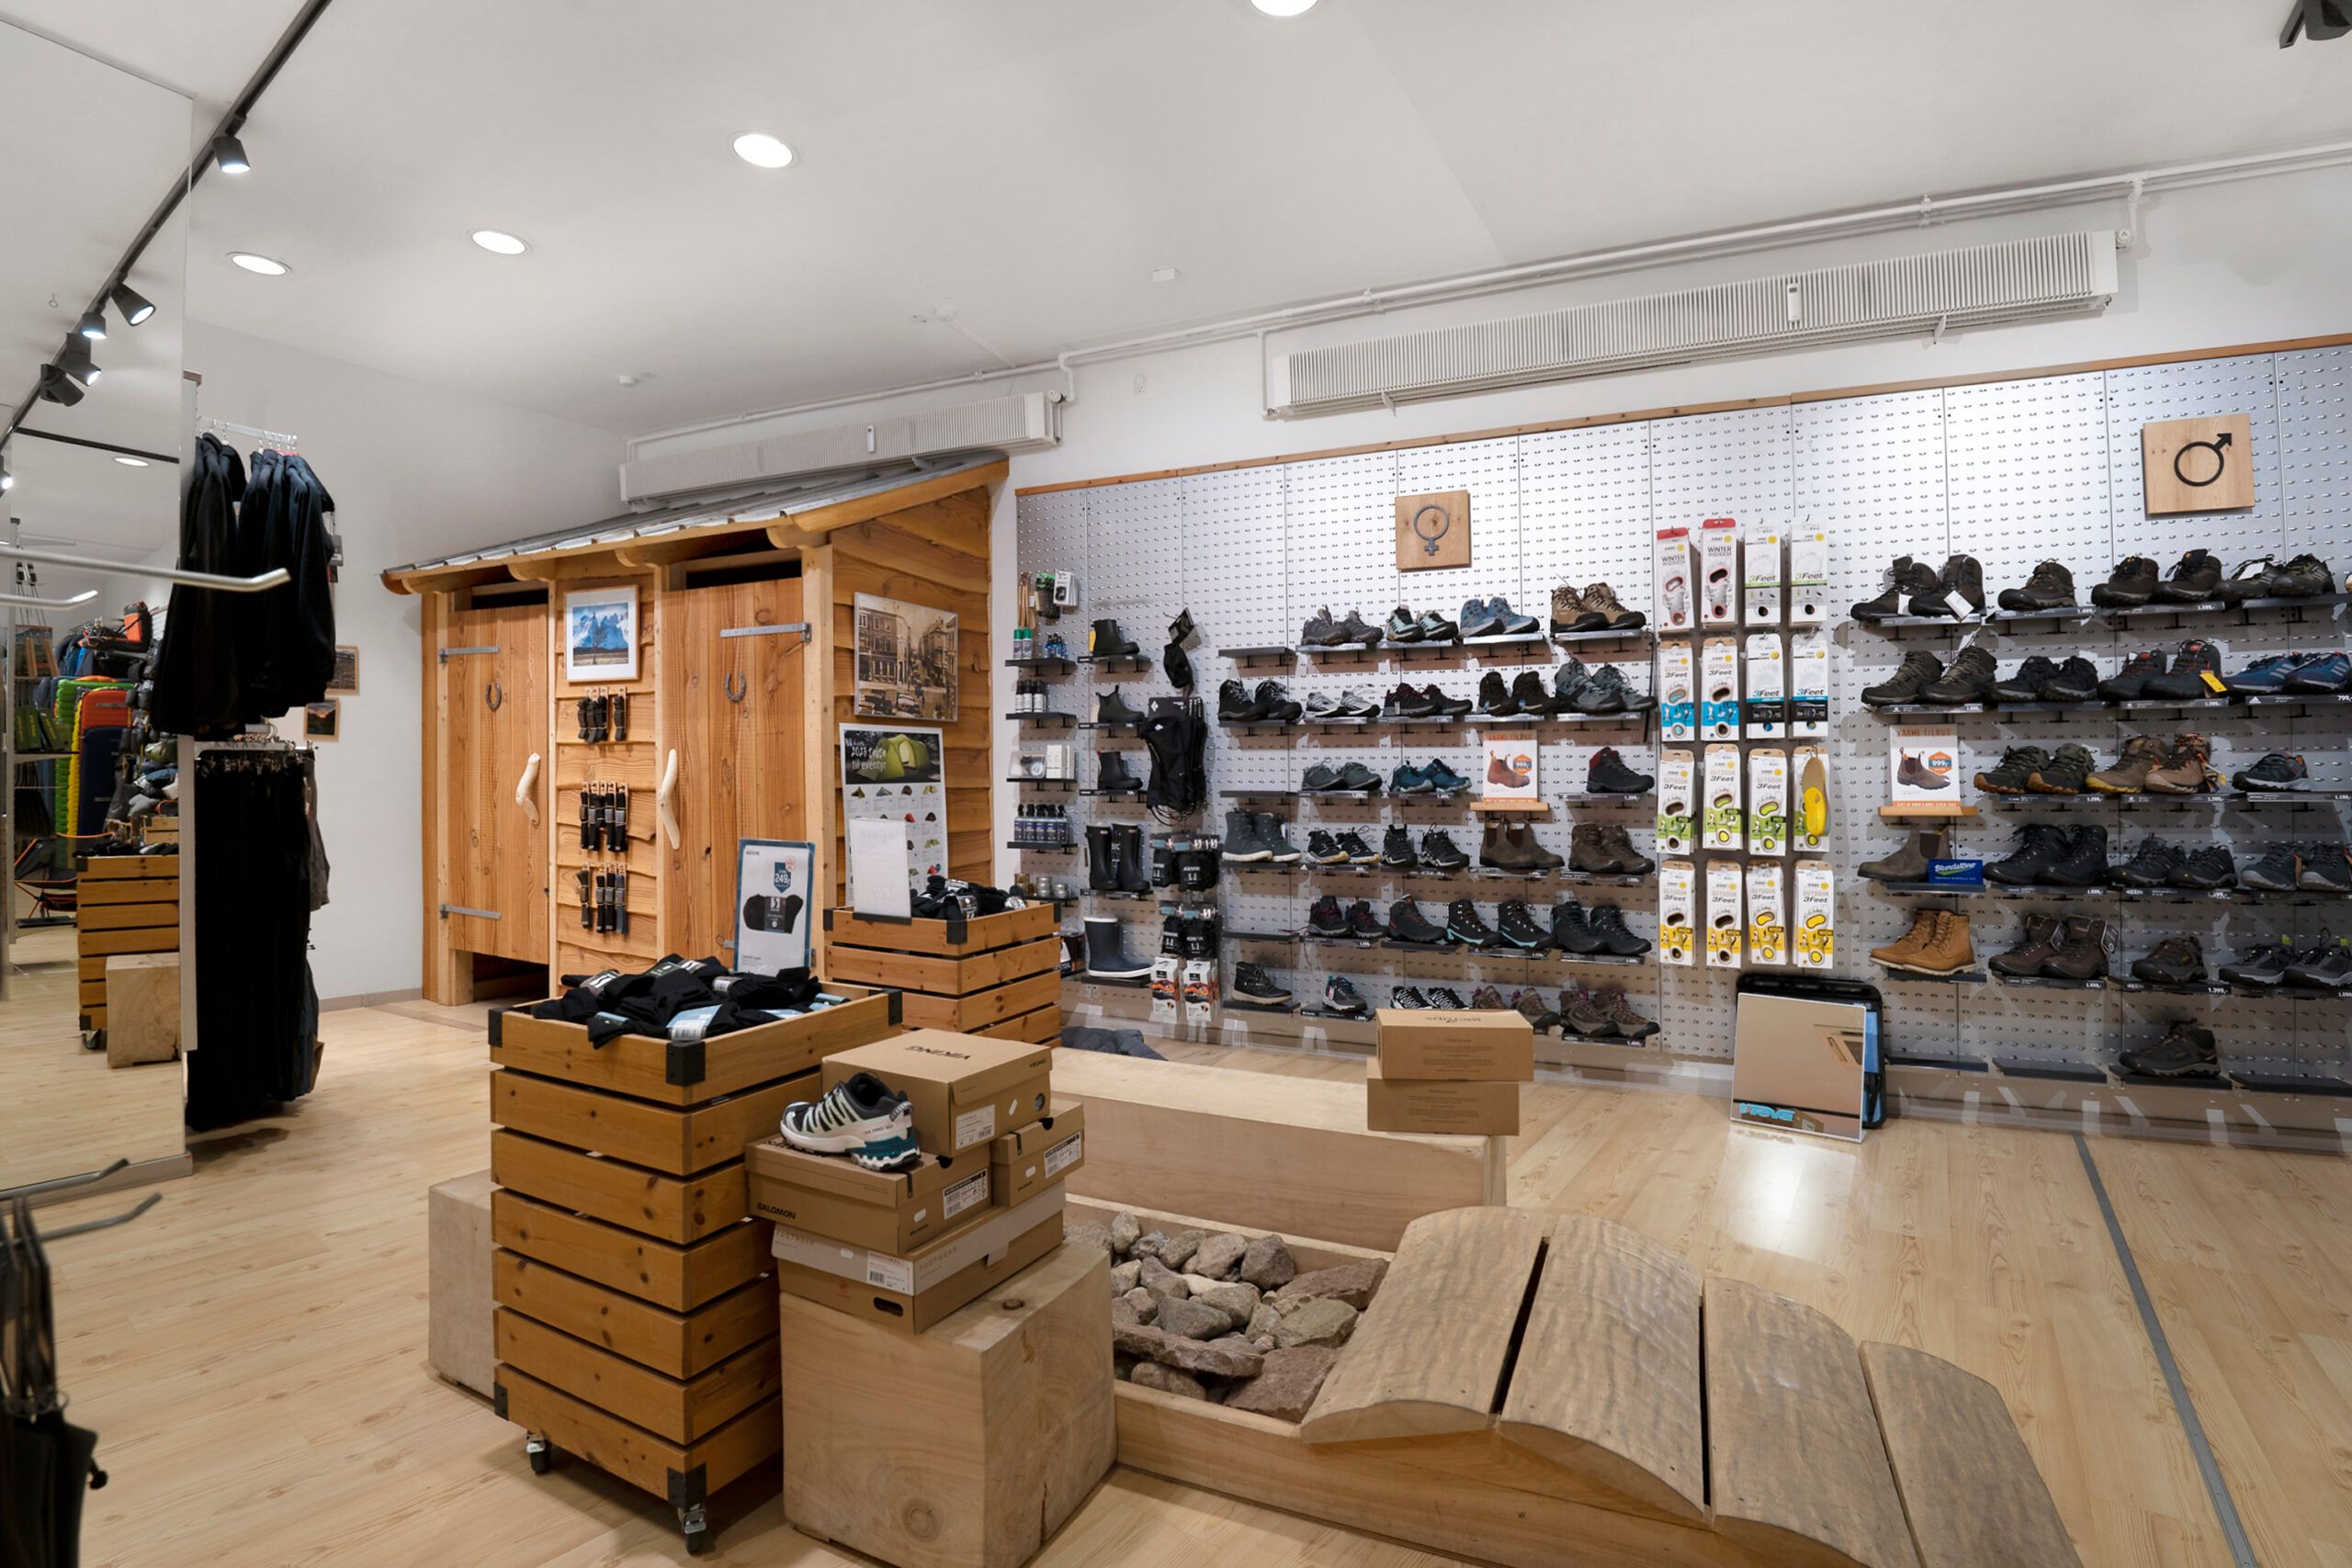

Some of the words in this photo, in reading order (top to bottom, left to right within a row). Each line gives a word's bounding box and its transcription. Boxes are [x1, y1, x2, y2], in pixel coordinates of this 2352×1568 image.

[1795, 572, 1824, 581] 3Feet
[1934, 862, 1977, 873] Blundstone
[905, 1045, 971, 1060] VIKING
[757, 1201, 797, 1220] SALOMON
